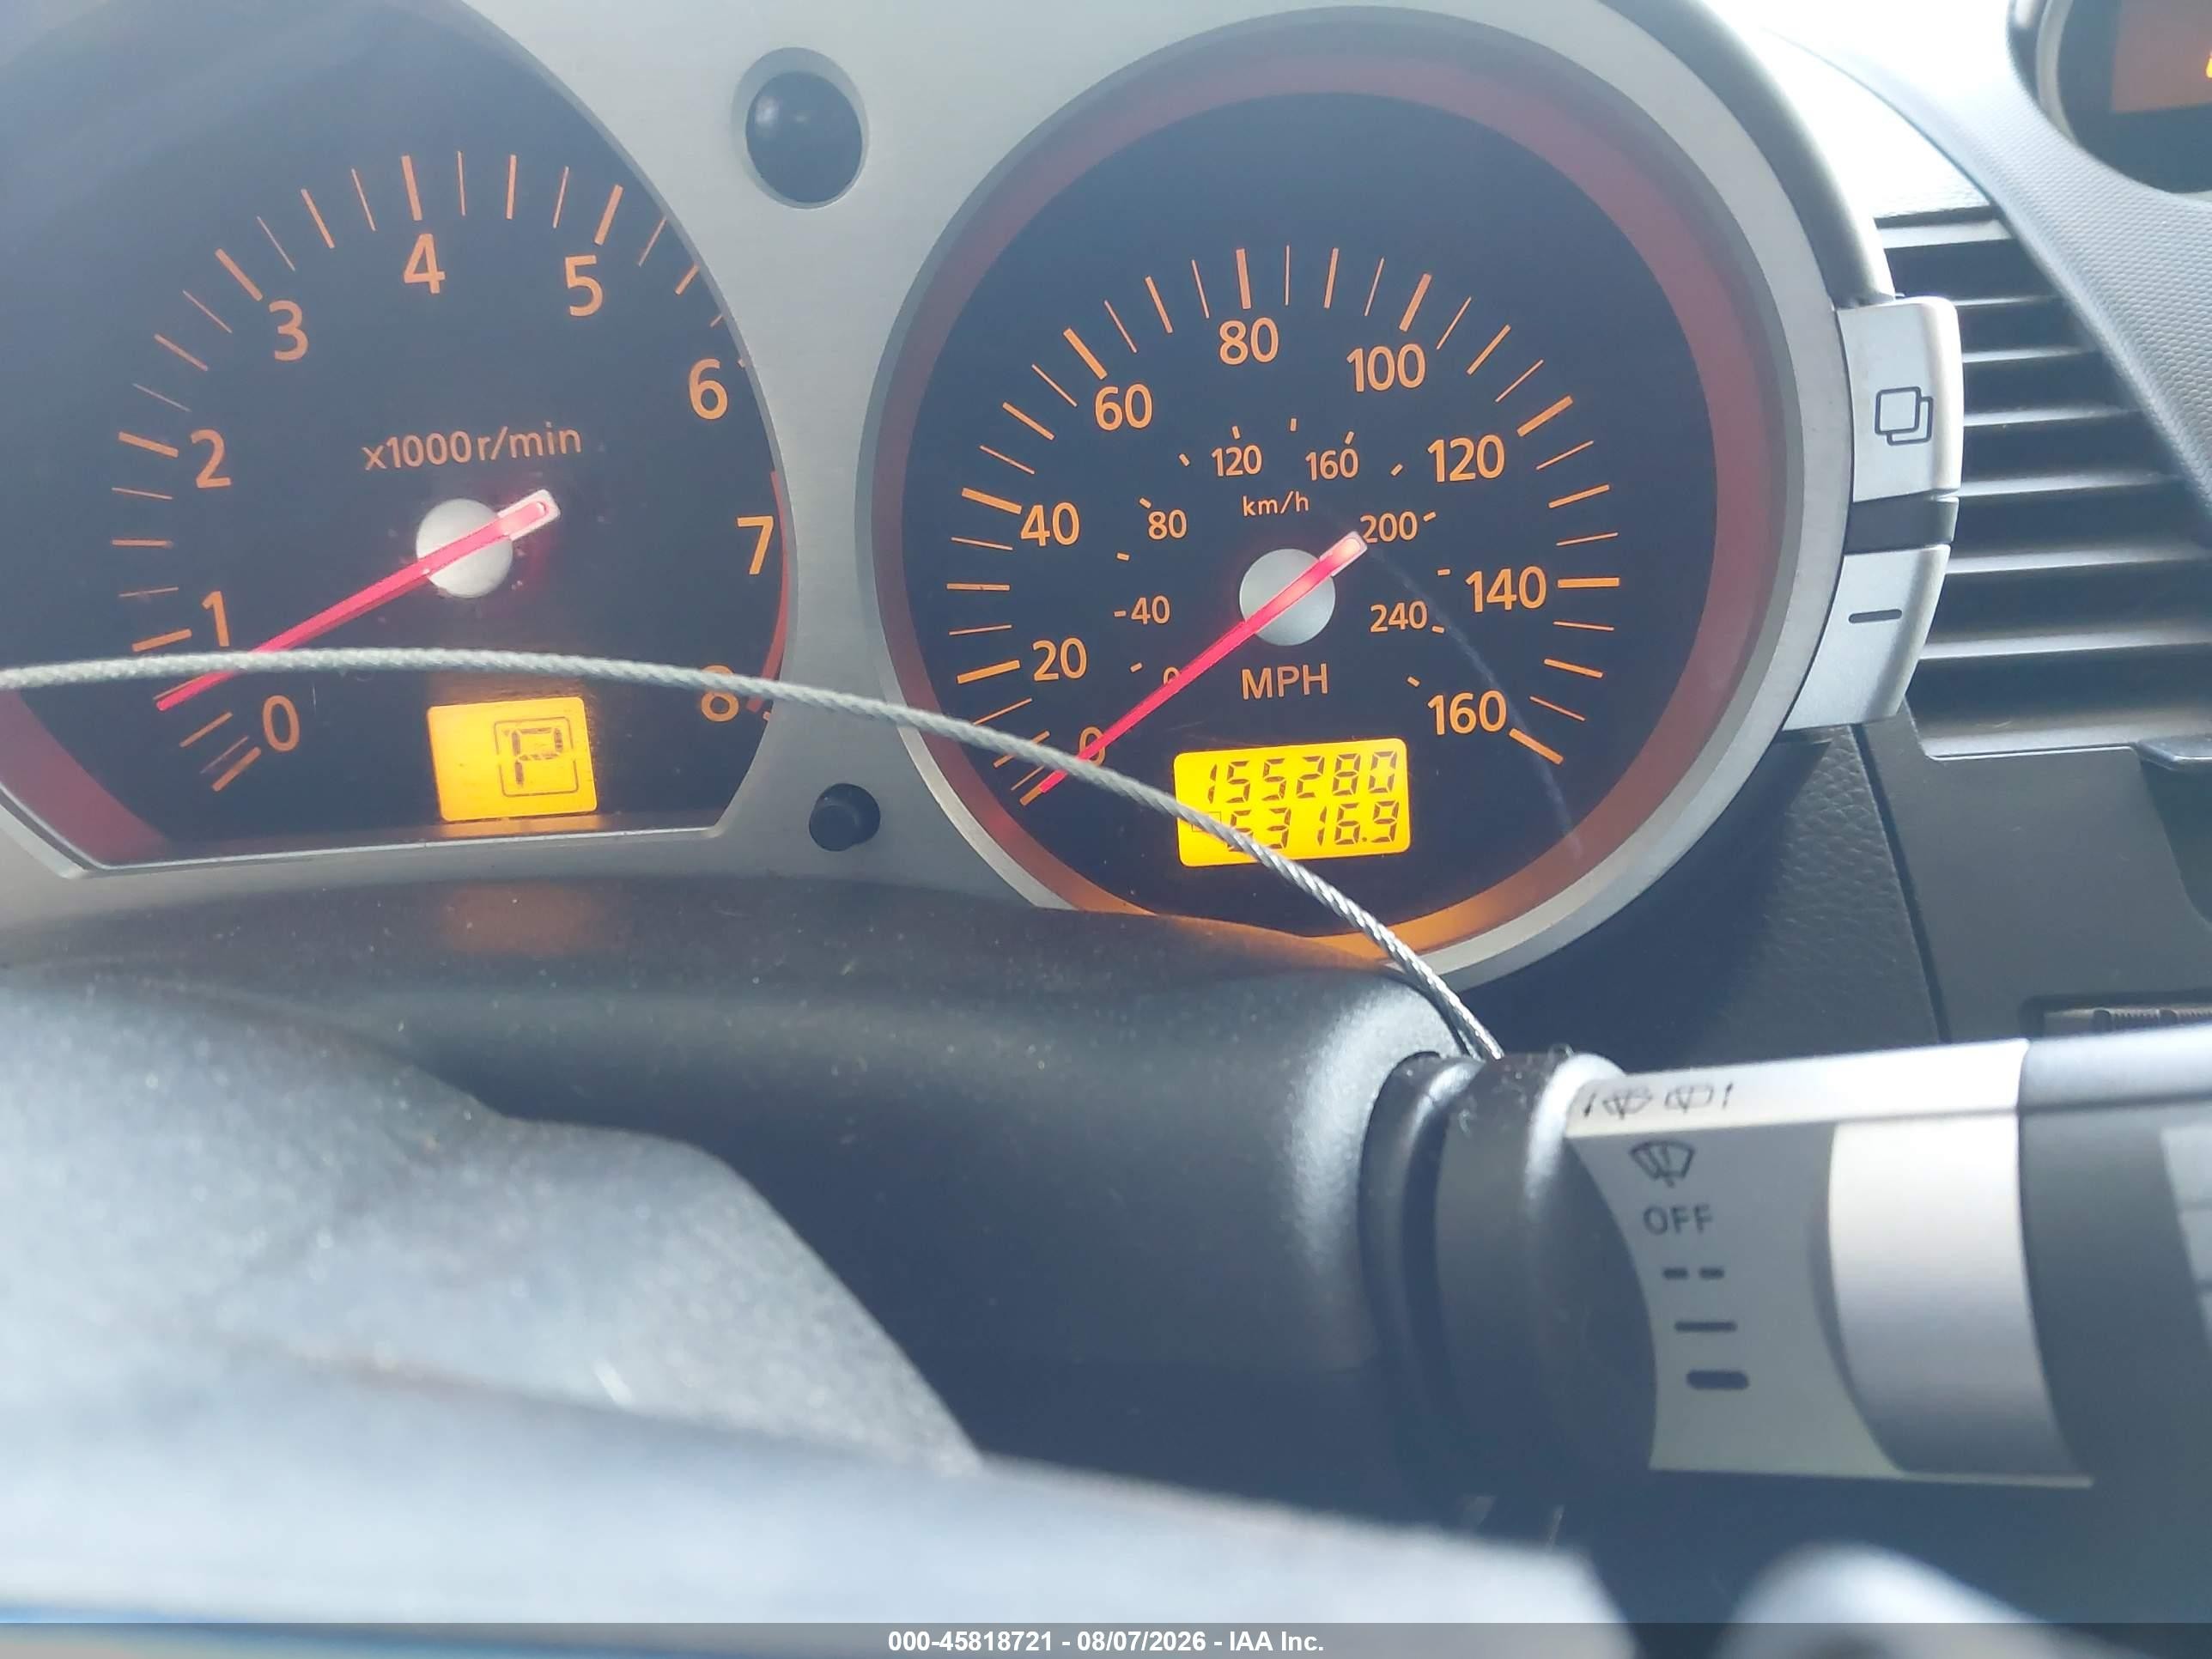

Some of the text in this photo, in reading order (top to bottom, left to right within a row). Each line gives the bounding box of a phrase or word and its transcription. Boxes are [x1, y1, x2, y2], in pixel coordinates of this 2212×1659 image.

[403, 233, 446, 295] 4
[564, 254, 604, 317] 5
[270, 301, 308, 362] 3
[1218, 317, 1279, 366] 80
[689, 357, 729, 421] 6
[1346, 343, 1426, 393] 100
[1094, 381, 1154, 432] 60
[191, 428, 231, 489] 2
[1212, 444, 1263, 477] 120
[1305, 448, 1360, 482] 160
[1428, 434, 1506, 484] 120
[1020, 502, 1081, 548] 40
[1147, 507, 1188, 541] 80
[1241, 491, 1310, 517] km/h
[1359, 514, 1419, 544] 200
[736, 514, 775, 576] 7
[1130, 594, 1171, 625] 40
[1465, 564, 1548, 614] 140
[201, 590, 231, 647] 1
[1369, 599, 1429, 634] 240
[1031, 636, 1089, 683] 20
[1240, 662, 1329, 701] MPH
[701, 664, 740, 722] 8
[1427, 689, 1508, 737] 160
[261, 695, 300, 752] 0
[509, 726, 564, 787] P
[1207, 750, 1398, 804] 155280
[1643, 1204, 1714, 1236] OFF
